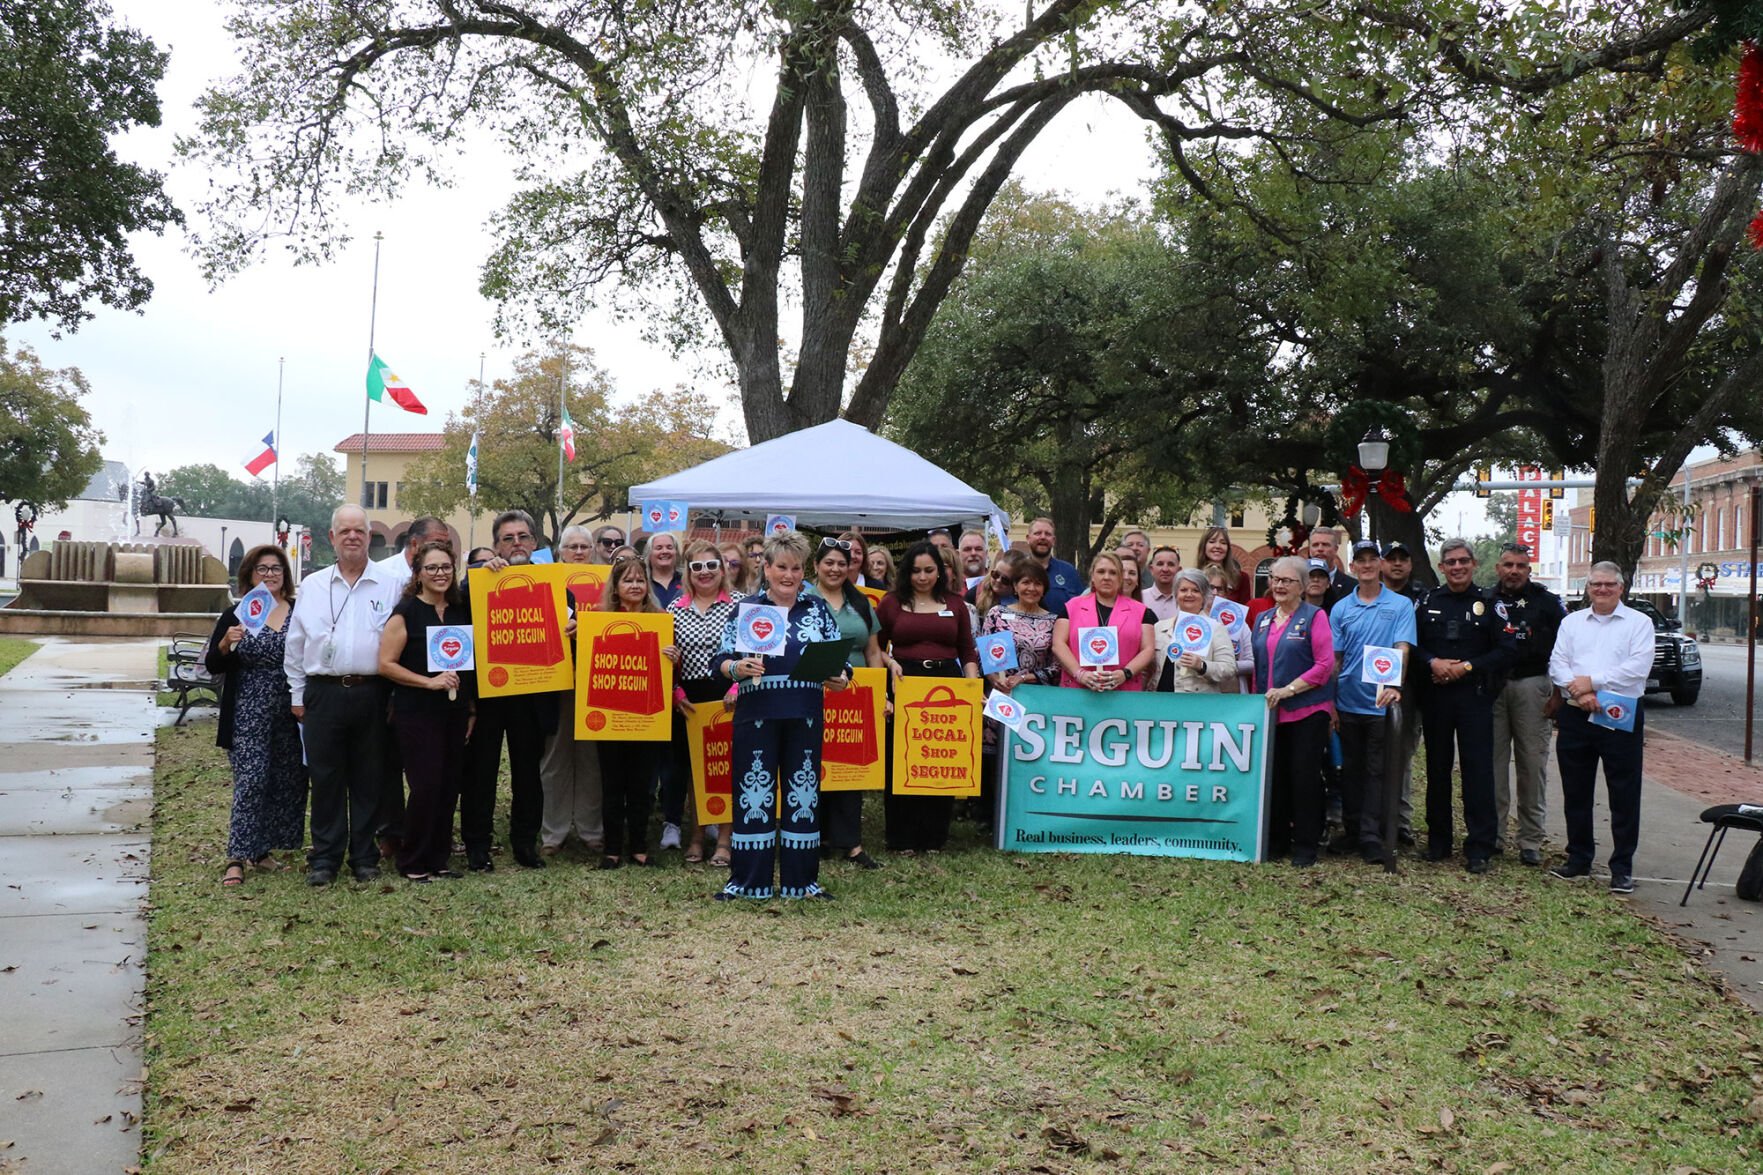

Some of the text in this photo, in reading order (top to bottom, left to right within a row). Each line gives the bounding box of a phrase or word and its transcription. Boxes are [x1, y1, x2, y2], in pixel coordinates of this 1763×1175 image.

[1523, 471, 1536, 558] PALACE
[516, 607, 544, 624] LOCAL
[516, 628, 546, 644] SEGUIN
[620, 654, 648, 671] LOCAL
[618, 674, 648, 691] SEGUIN
[838, 709, 864, 724] LOCAL
[836, 728, 864, 743] SEGUIN
[912, 727, 967, 742] LOCAL
[1014, 713, 1255, 773] SEGUIN
[1029, 776, 1228, 803] CHAMBER
[1015, 828, 1242, 853] Real business, leaders, community.
